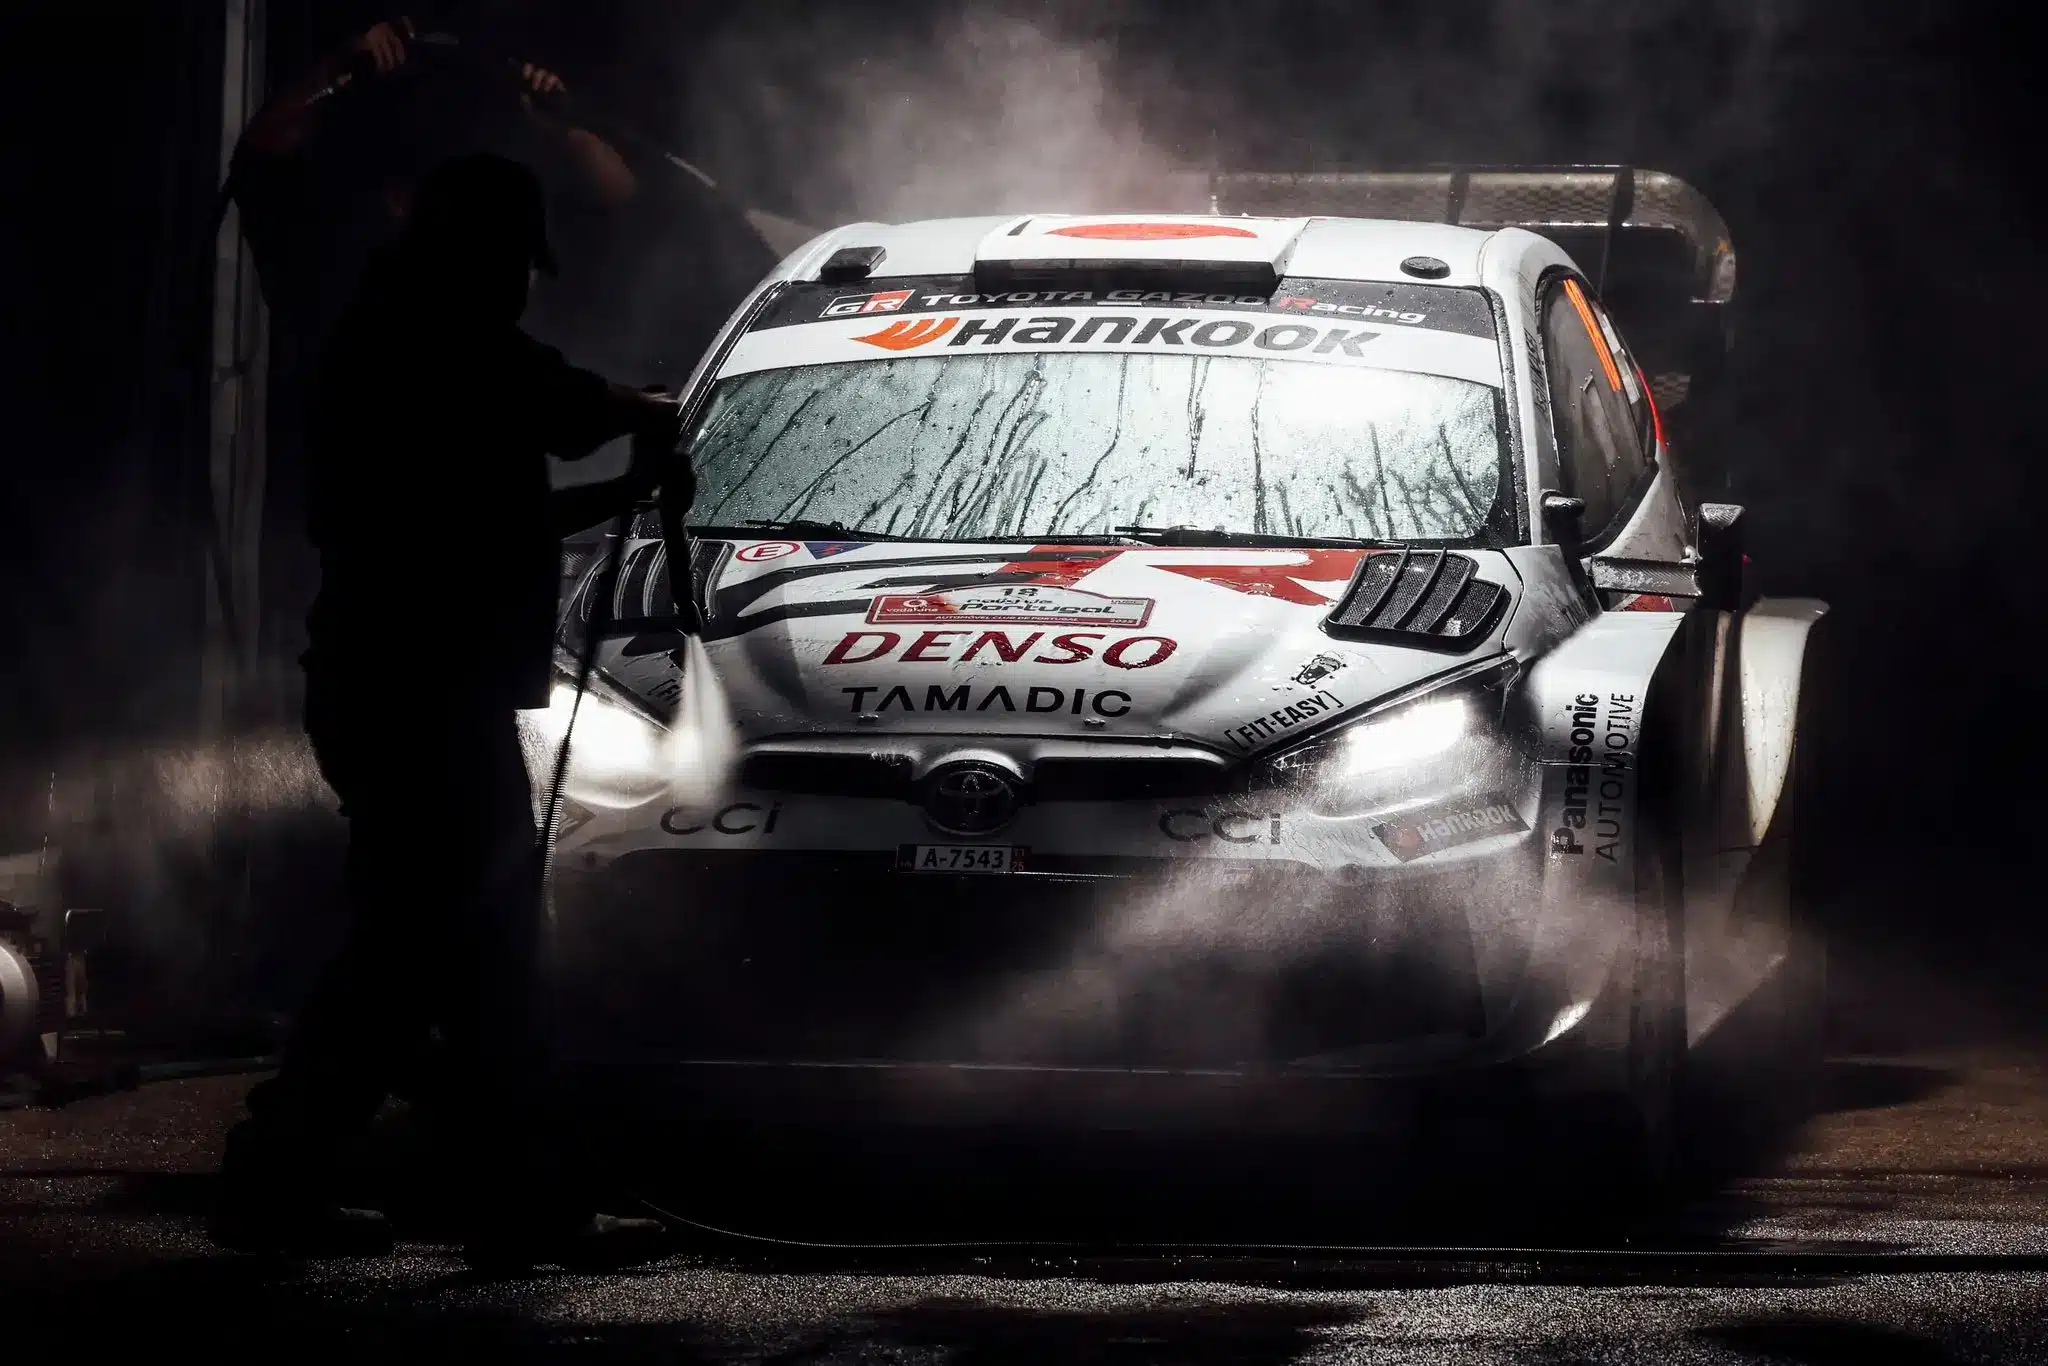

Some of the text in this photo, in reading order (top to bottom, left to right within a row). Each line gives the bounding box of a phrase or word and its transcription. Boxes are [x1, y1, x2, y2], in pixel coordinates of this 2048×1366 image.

[826, 297, 899, 315] GR
[921, 291, 1092, 306] TOYOTA
[1279, 296, 1426, 324] Racing
[753, 546, 782, 557] E
[959, 603, 1115, 614] Portugal
[822, 631, 1178, 670] DENSO
[842, 685, 1132, 717] TAMADIC
[1551, 693, 1599, 855] Panasonic
[1596, 693, 1634, 863] AUTOMOTIVE
[922, 848, 1004, 869] A-7543
